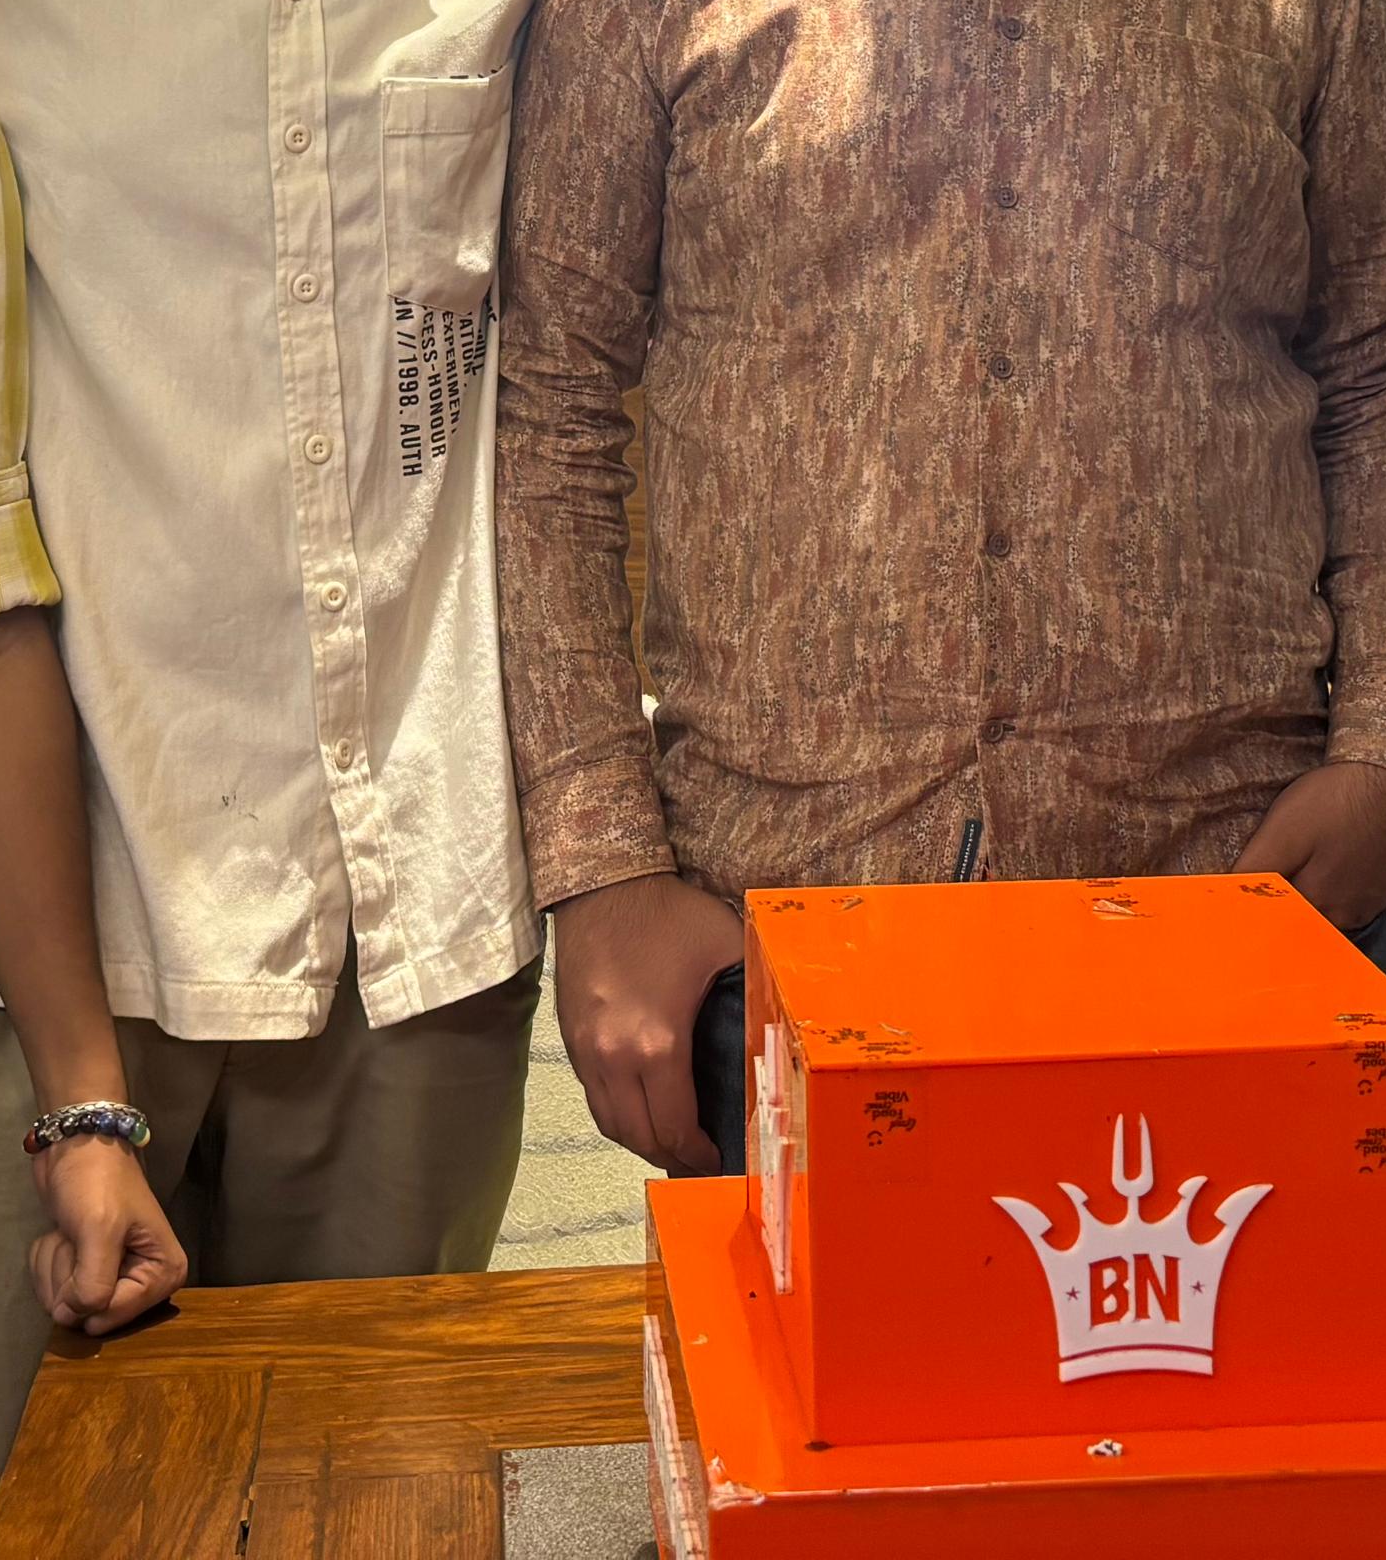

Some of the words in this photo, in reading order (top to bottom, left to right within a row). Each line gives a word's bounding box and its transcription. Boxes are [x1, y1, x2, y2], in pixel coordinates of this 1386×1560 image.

[421, 305, 447, 459] CESS-HONOUR
[441, 309, 460, 434] EXPERIMEN
[400, 423, 423, 477] AUTH
[874, 1091, 910, 1103] Vibes
[1088, 1253, 1181, 1329] BN
